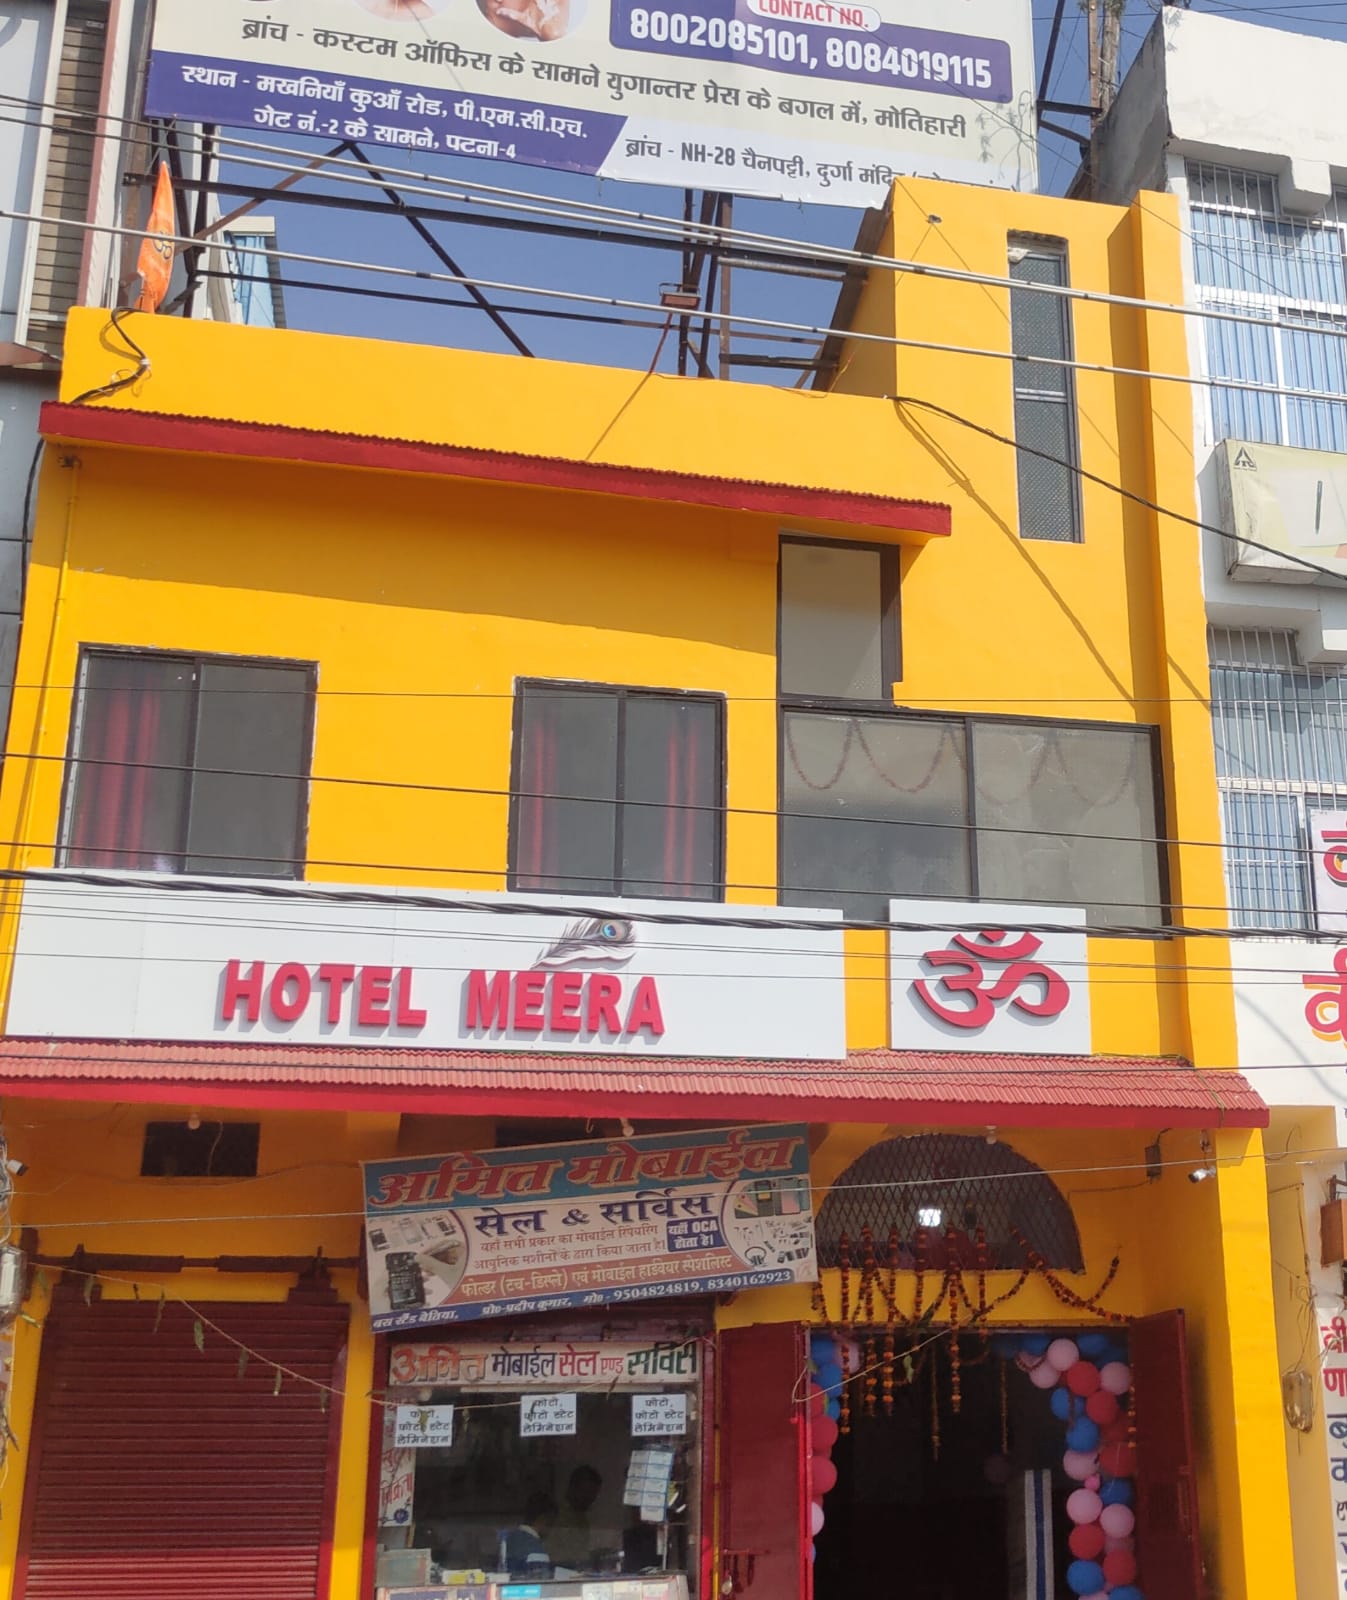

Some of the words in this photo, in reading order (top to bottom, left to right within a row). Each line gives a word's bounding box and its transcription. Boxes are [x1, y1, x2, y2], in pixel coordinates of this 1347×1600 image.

[759, 0, 833, 22] CONTACT
[840, 8, 869, 27] NO.
[630, 8, 818, 70] 8002085101,
[826, 38, 992, 89] 8084019115
[182, 65, 237, 88] स्थान
[256, 75, 346, 103] मखनियाँ
[349, 87, 401, 114] कुआँ
[406, 93, 448, 119] रोड,
[453, 98, 588, 139] पी.एम.सी.एच.
[242, 15, 288, 42] ब्रांच
[313, 27, 396, 59] कस्टम
[405, 38, 491, 72] ऑफिस
[499, 52, 525, 76] के
[532, 60, 600, 89] सामने
[607, 71, 696, 100] युगान्तर
[703, 78, 739, 106] प्रेस
[747, 88, 771, 110] के
[778, 96, 833, 121] बगल
[841, 100, 868, 126] में,
[875, 106, 966, 138] मोतिहारी
[254, 104, 292, 128] गेट
[344, 118, 371, 140] के
[375, 126, 441, 150] सामने,
[446, 132, 516, 160] पटना-4
[625, 134, 662, 159] ब्रांच
[681, 142, 736, 167] NH-28
[816, 161, 854, 188] दुर्गा
[222, 958, 427, 1028] HOTEL
[466, 968, 665, 1036] MEERA
[368, 1151, 564, 1207] अमित
[566, 1129, 804, 1188] मोबाईल
[474, 1207, 548, 1237] सेल
[562, 1209, 590, 1227] &
[599, 1188, 716, 1224] सर्विस
[529, 1234, 555, 1248] प्रकार
[707, 1270, 791, 1290] 8340162923
[491, 1345, 558, 1378] मोबाईल
[559, 1343, 600, 1377] सेल
[600, 1356, 624, 1375] एण्ड
[398, 1420, 425, 1431] फोट
[635, 1409, 660, 1420] फोटो
